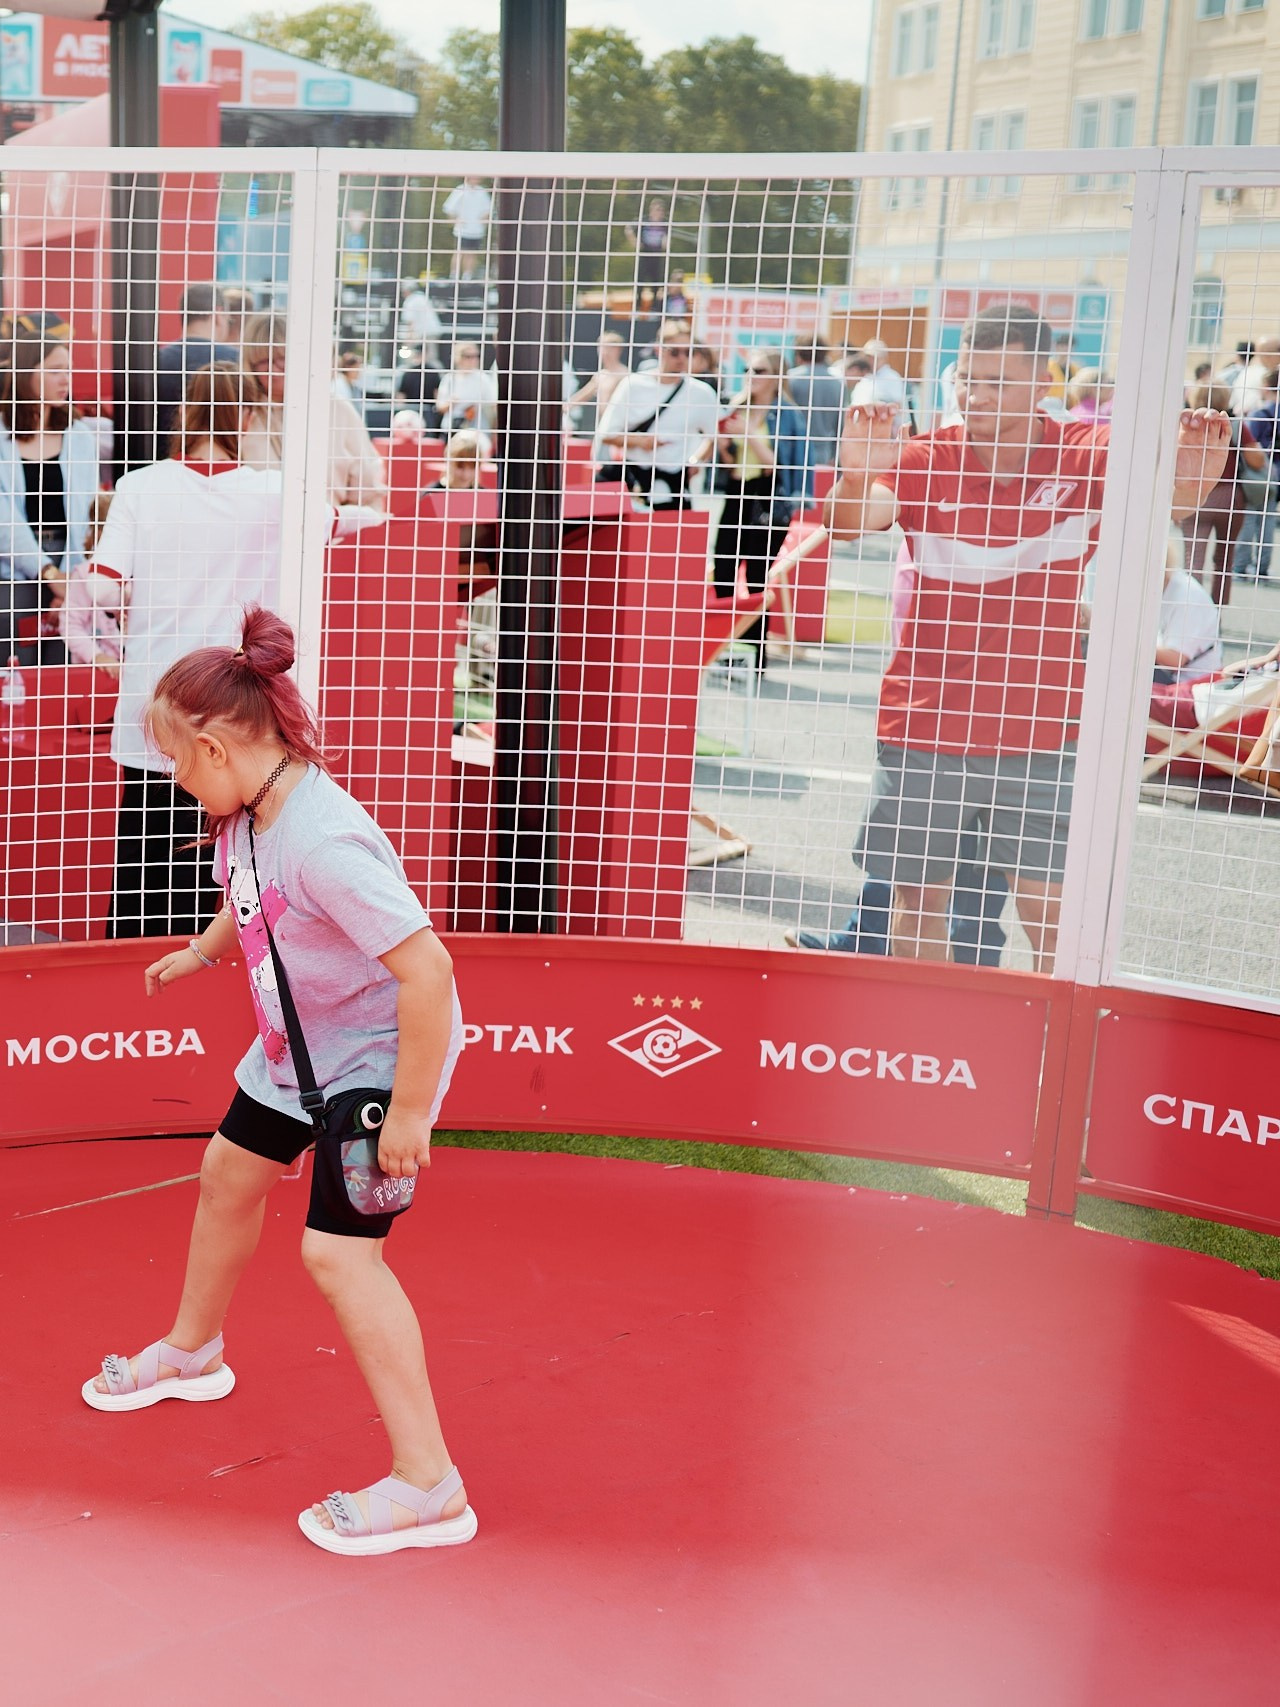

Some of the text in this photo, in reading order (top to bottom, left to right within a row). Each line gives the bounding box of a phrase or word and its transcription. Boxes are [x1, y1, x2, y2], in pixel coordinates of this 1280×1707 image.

[5, 1028, 206, 1067] МОСКВА
[461, 1024, 574, 1055] РТАК
[759, 1039, 977, 1090] МОСКВА
[1143, 1093, 1280, 1146] СПАР
